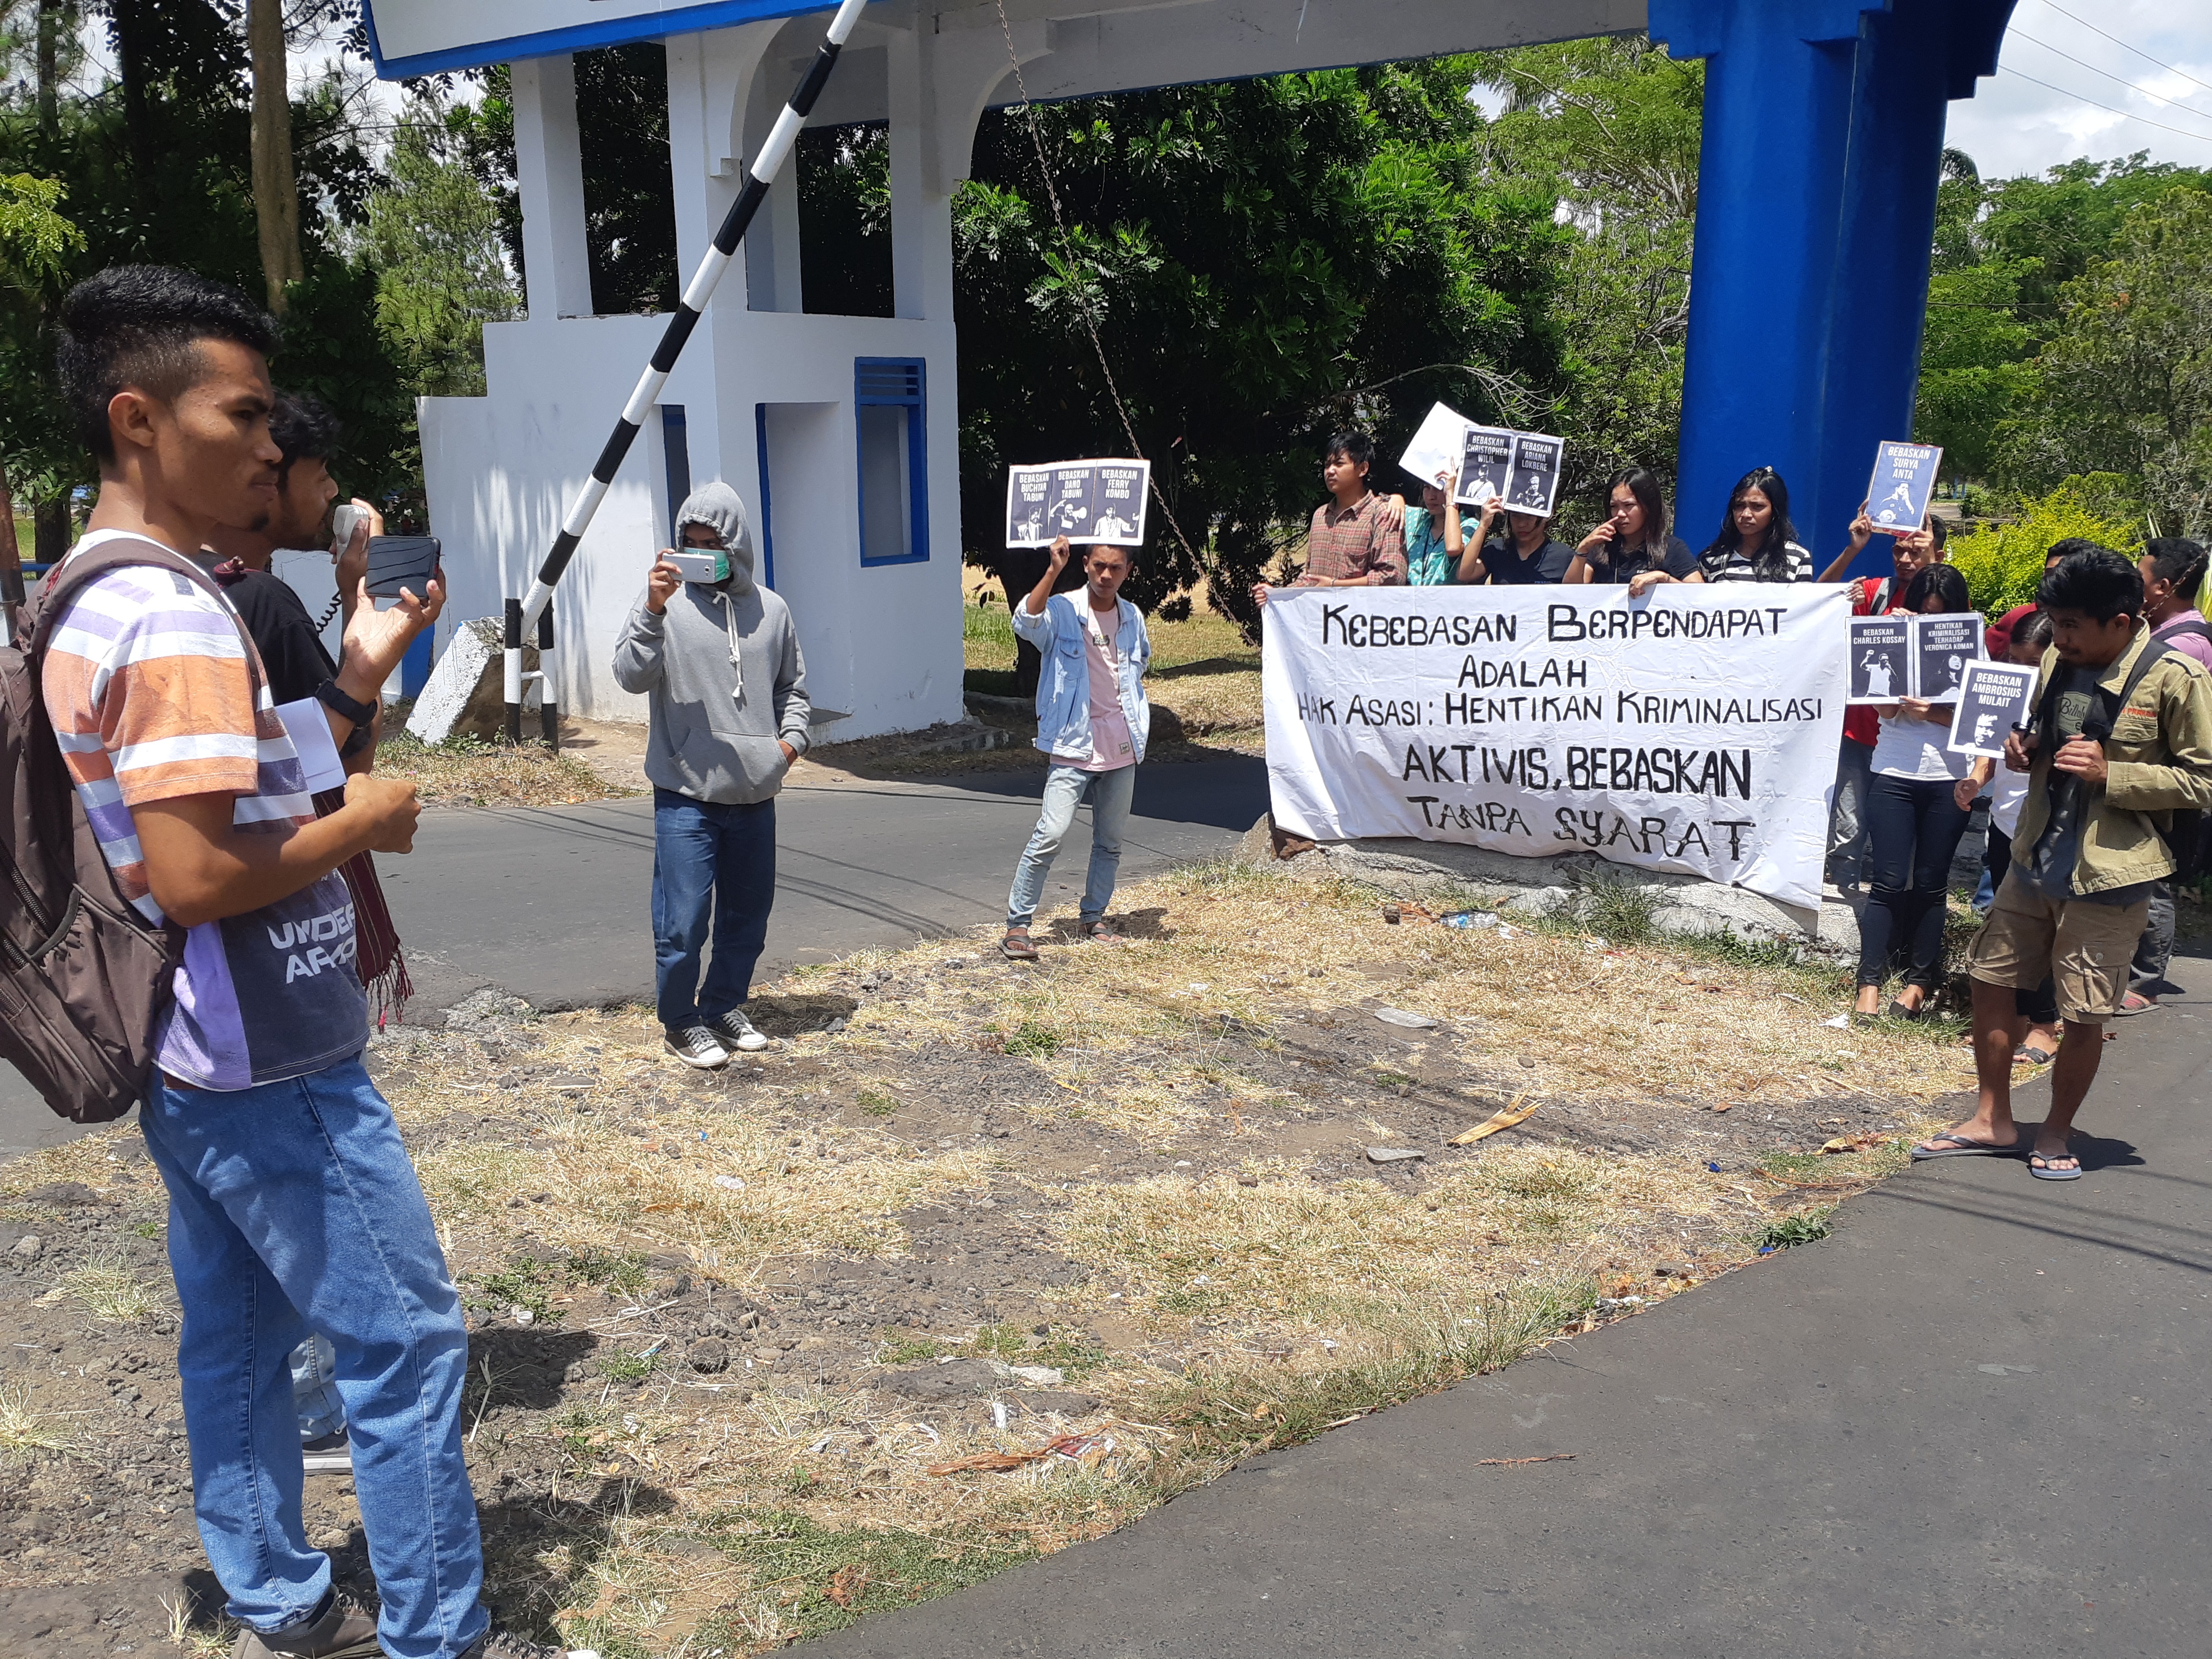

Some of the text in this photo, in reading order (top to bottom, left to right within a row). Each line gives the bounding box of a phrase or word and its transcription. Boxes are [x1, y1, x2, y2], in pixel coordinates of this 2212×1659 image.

[1472, 436, 1504, 446] BEBASKAN
[1467, 444, 1508, 456] CHRISTOPHER
[1521, 441, 1552, 455] BEBASKAN
[1888, 446, 1930, 459] BEBASKAN
[1478, 455, 1495, 464] WILIL
[1525, 451, 1546, 461] ARIANA
[1522, 459, 1548, 472] LOKBERE
[1893, 458, 1919, 469] SURYA
[1019, 472, 1049, 483] BEBASKAN
[1058, 469, 1089, 480] BEBASKAN
[1102, 469, 1137, 480] BEBASKAN
[1892, 469, 1913, 480] ANTA
[1021, 483, 1046, 493] BUCHTAR
[1107, 480, 1129, 489] FERRY
[1023, 492, 1044, 502] TABUNI
[1061, 489, 1082, 498] TABUNI
[1106, 489, 1129, 499] KOMBO
[1322, 604, 1788, 647] KEBEBASAN BERPENDAPAT
[1928, 629, 1969, 637] KRIMINALISASI
[1882, 636, 1906, 644] KOSSAY
[1458, 654, 1587, 688] ADALAH
[1976, 673, 2022, 686] BEBASKAN
[1972, 684, 2022, 698] AMBROSIUS
[1979, 695, 2011, 707] MULAIT
[1297, 693, 1337, 725] HAK
[1445, 692, 1602, 724] HENTIKAN
[1617, 691, 1822, 723] KRIMINALISASI
[1566, 746, 1750, 800] BEBASKAN
[1407, 795, 1756, 861] TANPA SYARAT
